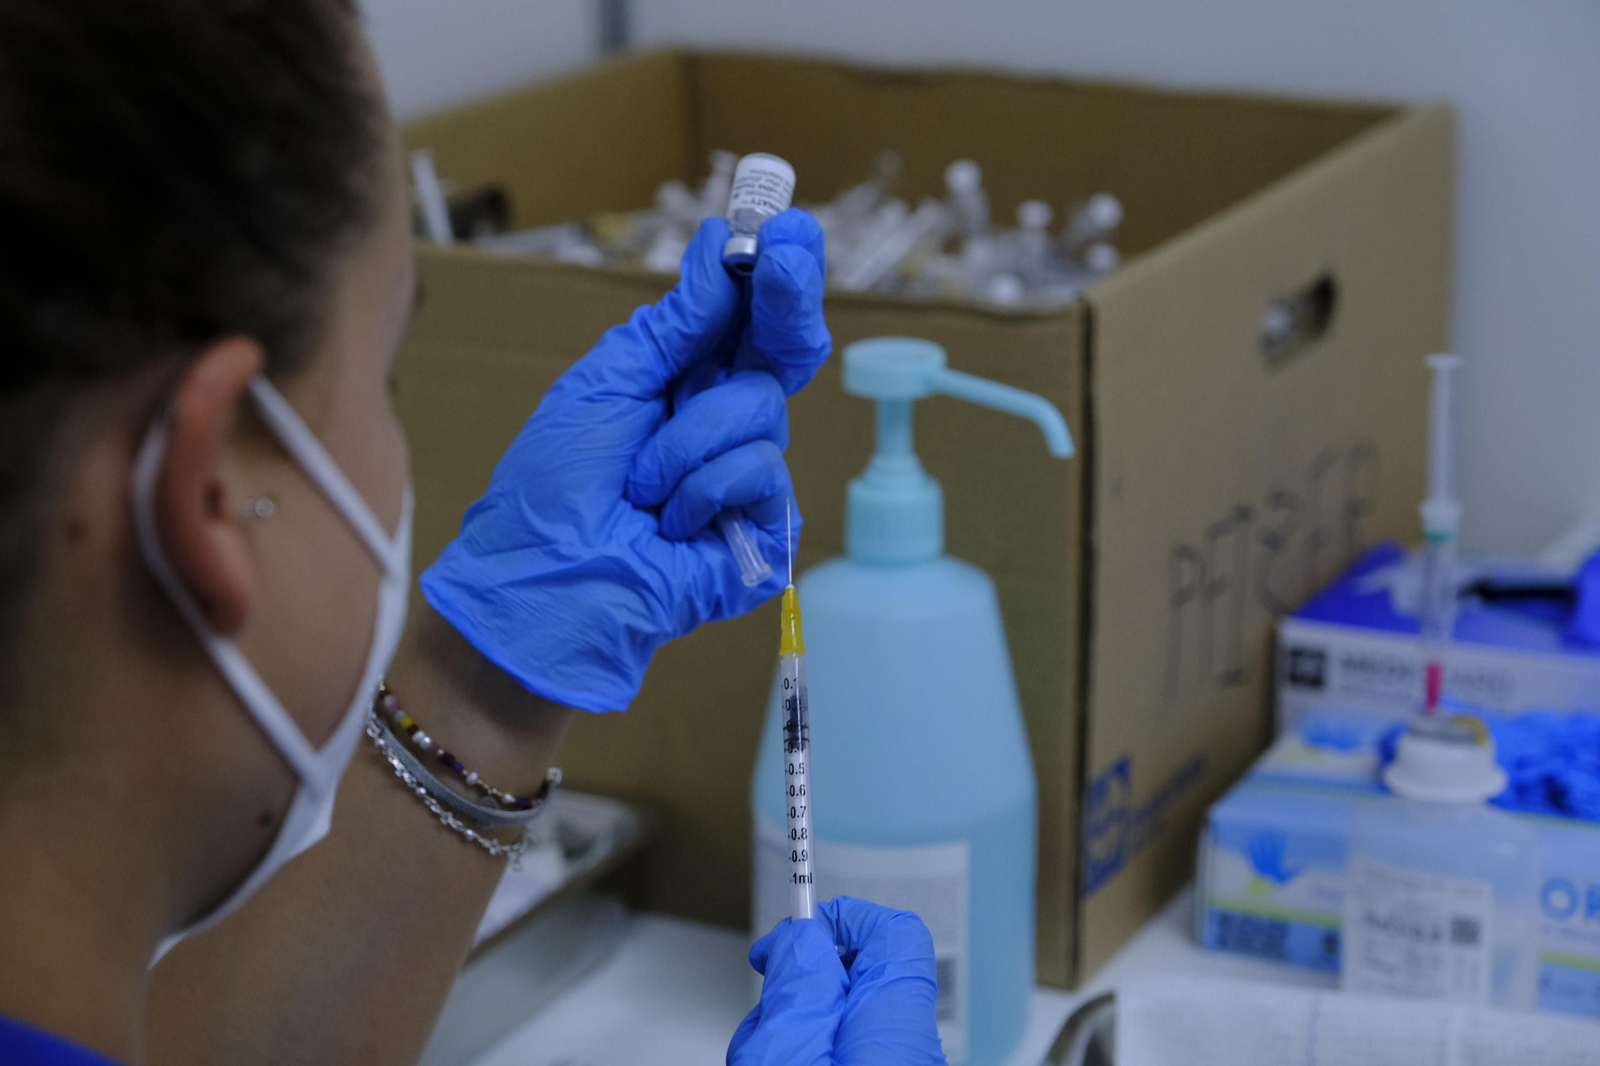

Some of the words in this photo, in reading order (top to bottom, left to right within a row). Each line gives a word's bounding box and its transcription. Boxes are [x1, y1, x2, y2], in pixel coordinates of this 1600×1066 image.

[786, 720, 802, 733] 0.
[788, 762, 805, 775] 0.5
[789, 784, 806, 797] 0.6
[790, 806, 807, 819] 0.7
[791, 828, 808, 841] 0.8
[791, 849, 809, 863] 0.9
[792, 871, 813, 885] 1ml
